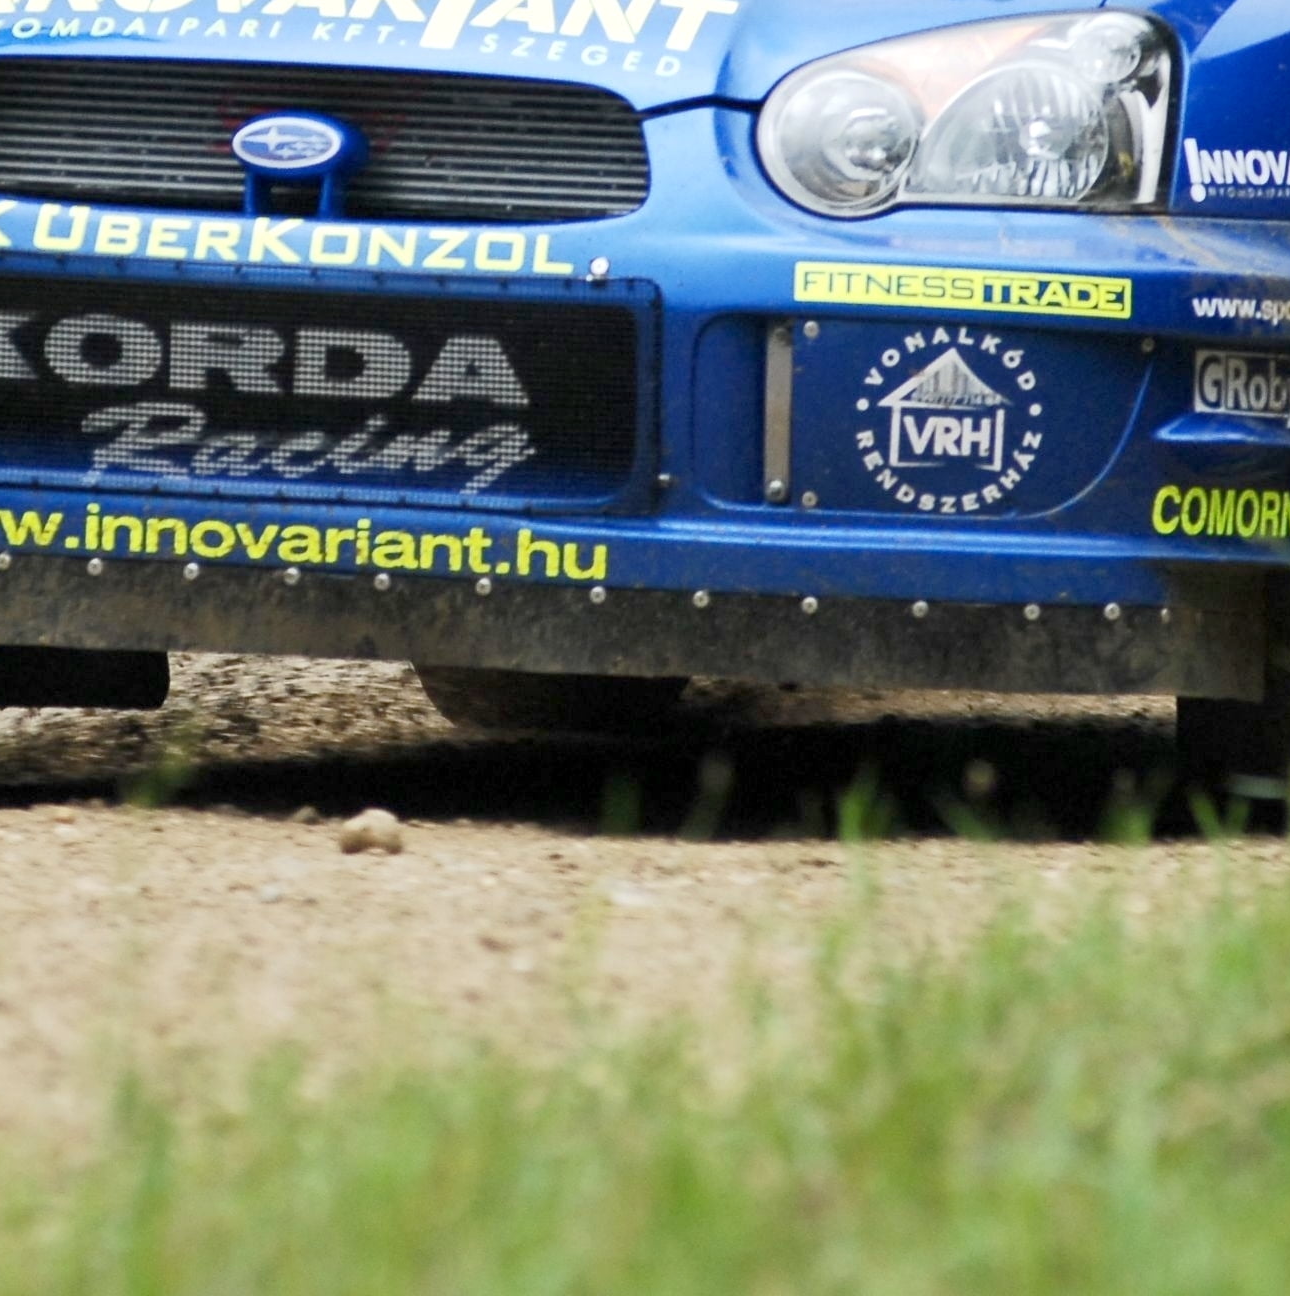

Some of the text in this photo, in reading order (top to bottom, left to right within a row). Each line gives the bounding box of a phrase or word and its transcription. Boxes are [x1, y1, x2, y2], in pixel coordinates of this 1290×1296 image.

[312, 22, 411, 48] KFT.
[481, 32, 684, 79] SZEGED
[80, 401, 538, 497] Racing
[902, 414, 992, 458] VRH
